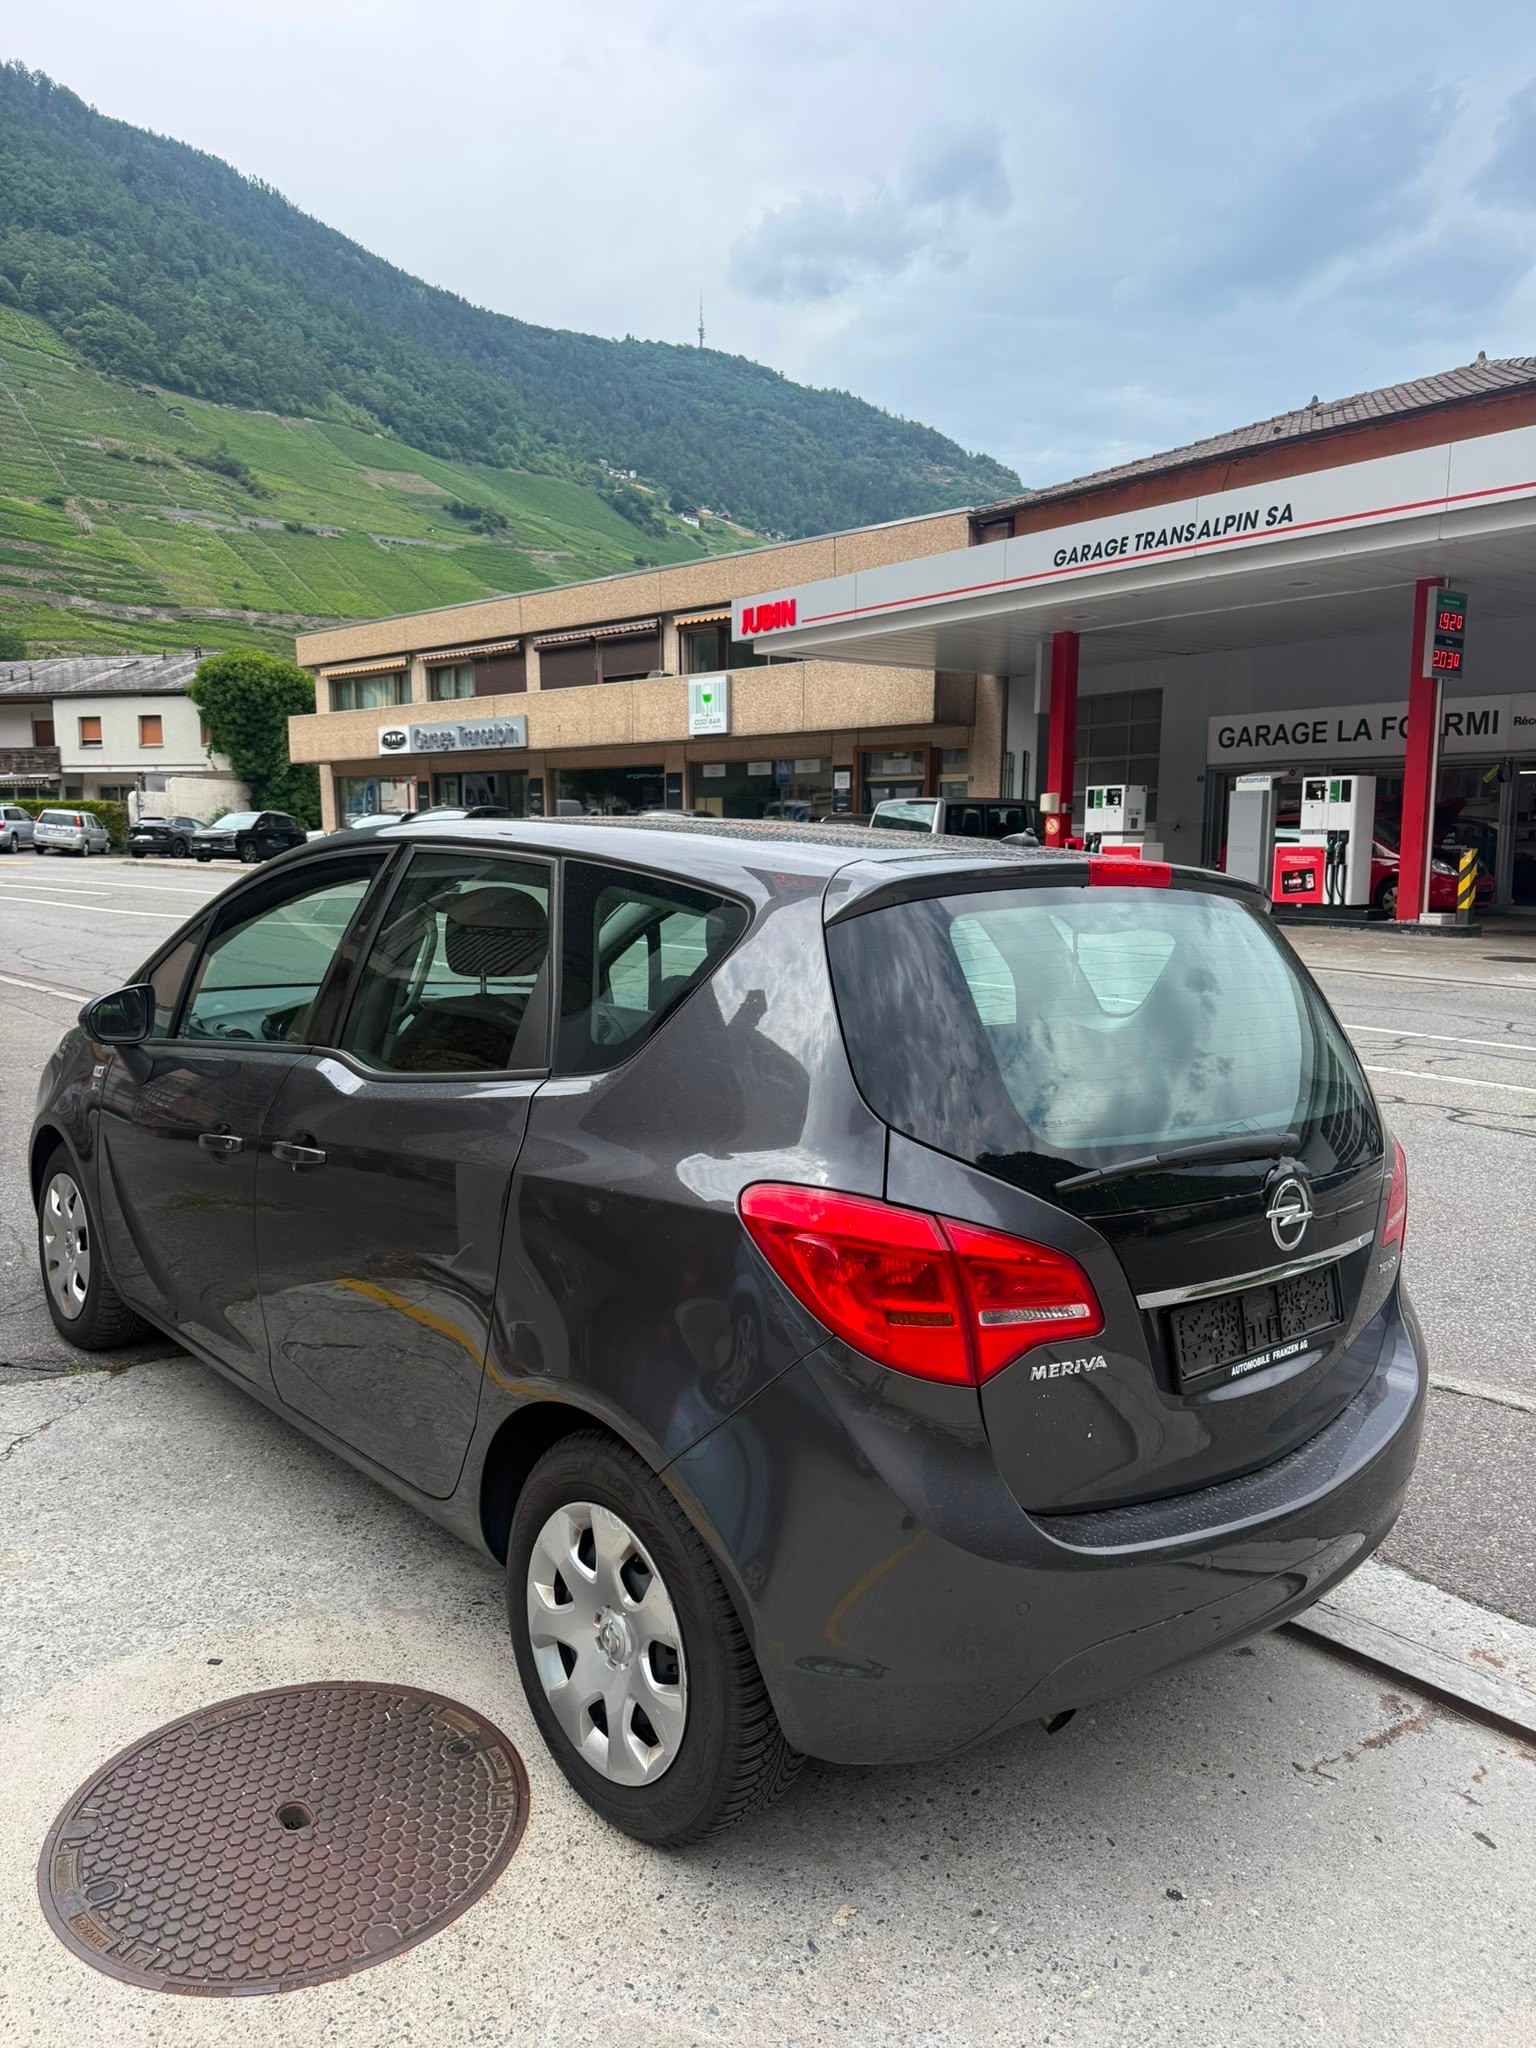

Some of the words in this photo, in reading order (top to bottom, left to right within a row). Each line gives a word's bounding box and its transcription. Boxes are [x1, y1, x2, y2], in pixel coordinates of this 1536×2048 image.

[1054, 536, 1129, 567] GARAGE
[1135, 509, 1260, 552] TRANSALPIN
[1265, 503, 1294, 526] SA
[741, 598, 796, 635] JUBIN
[414, 728, 455, 751] Garage
[457, 721, 519, 748] Transalpin
[1218, 720, 1328, 749] GARAGE
[1337, 718, 1373, 743] LA
[1237, 776, 1270, 785] Automate
[1315, 790, 1322, 799] 1
[1029, 1355, 1108, 1381] MERIVA
[1231, 1353, 1270, 1376] AUTOMOBILE
[1272, 1343, 1299, 1360] FRANZEN
[1299, 1339, 1308, 1350] AG
